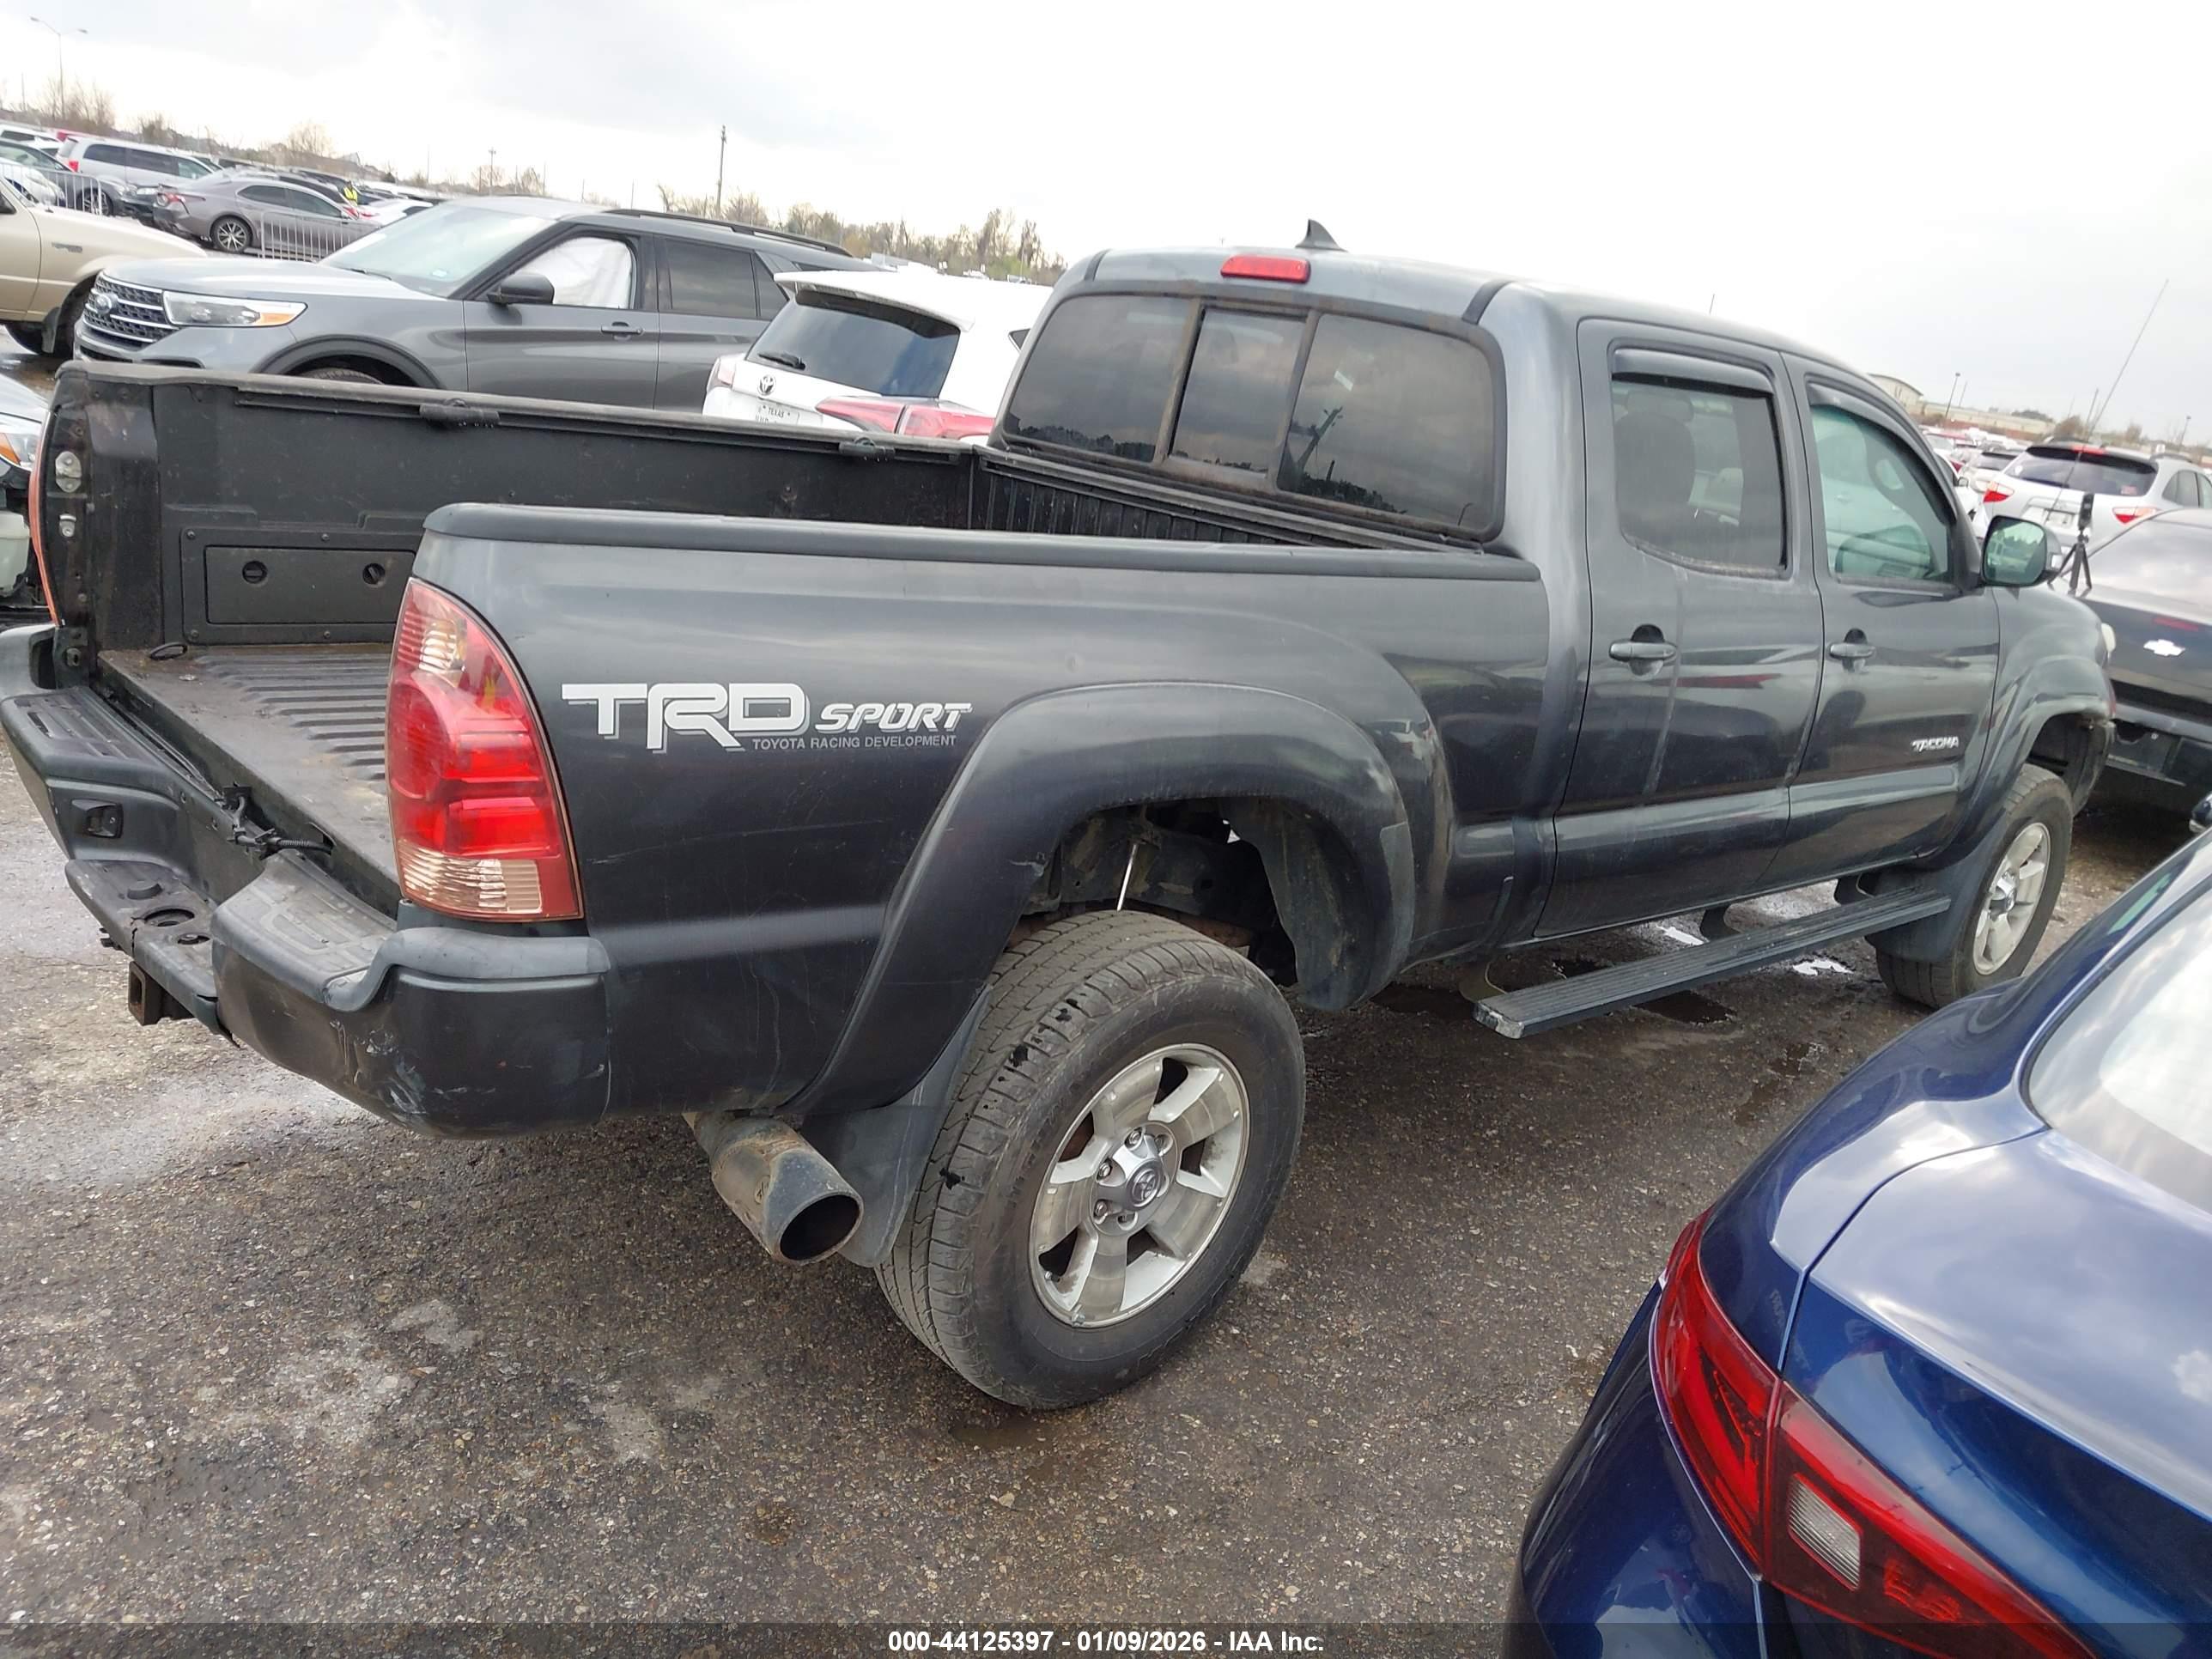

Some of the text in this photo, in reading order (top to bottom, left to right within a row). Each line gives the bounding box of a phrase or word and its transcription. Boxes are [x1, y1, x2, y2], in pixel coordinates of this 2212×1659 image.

[767, 406, 785, 418] TEXAS
[562, 683, 973, 754] TRD SPORT
[752, 734, 957, 750] TOYOTA RACING DEVELOPMENT
[1911, 736, 1960, 752] TACOMA
